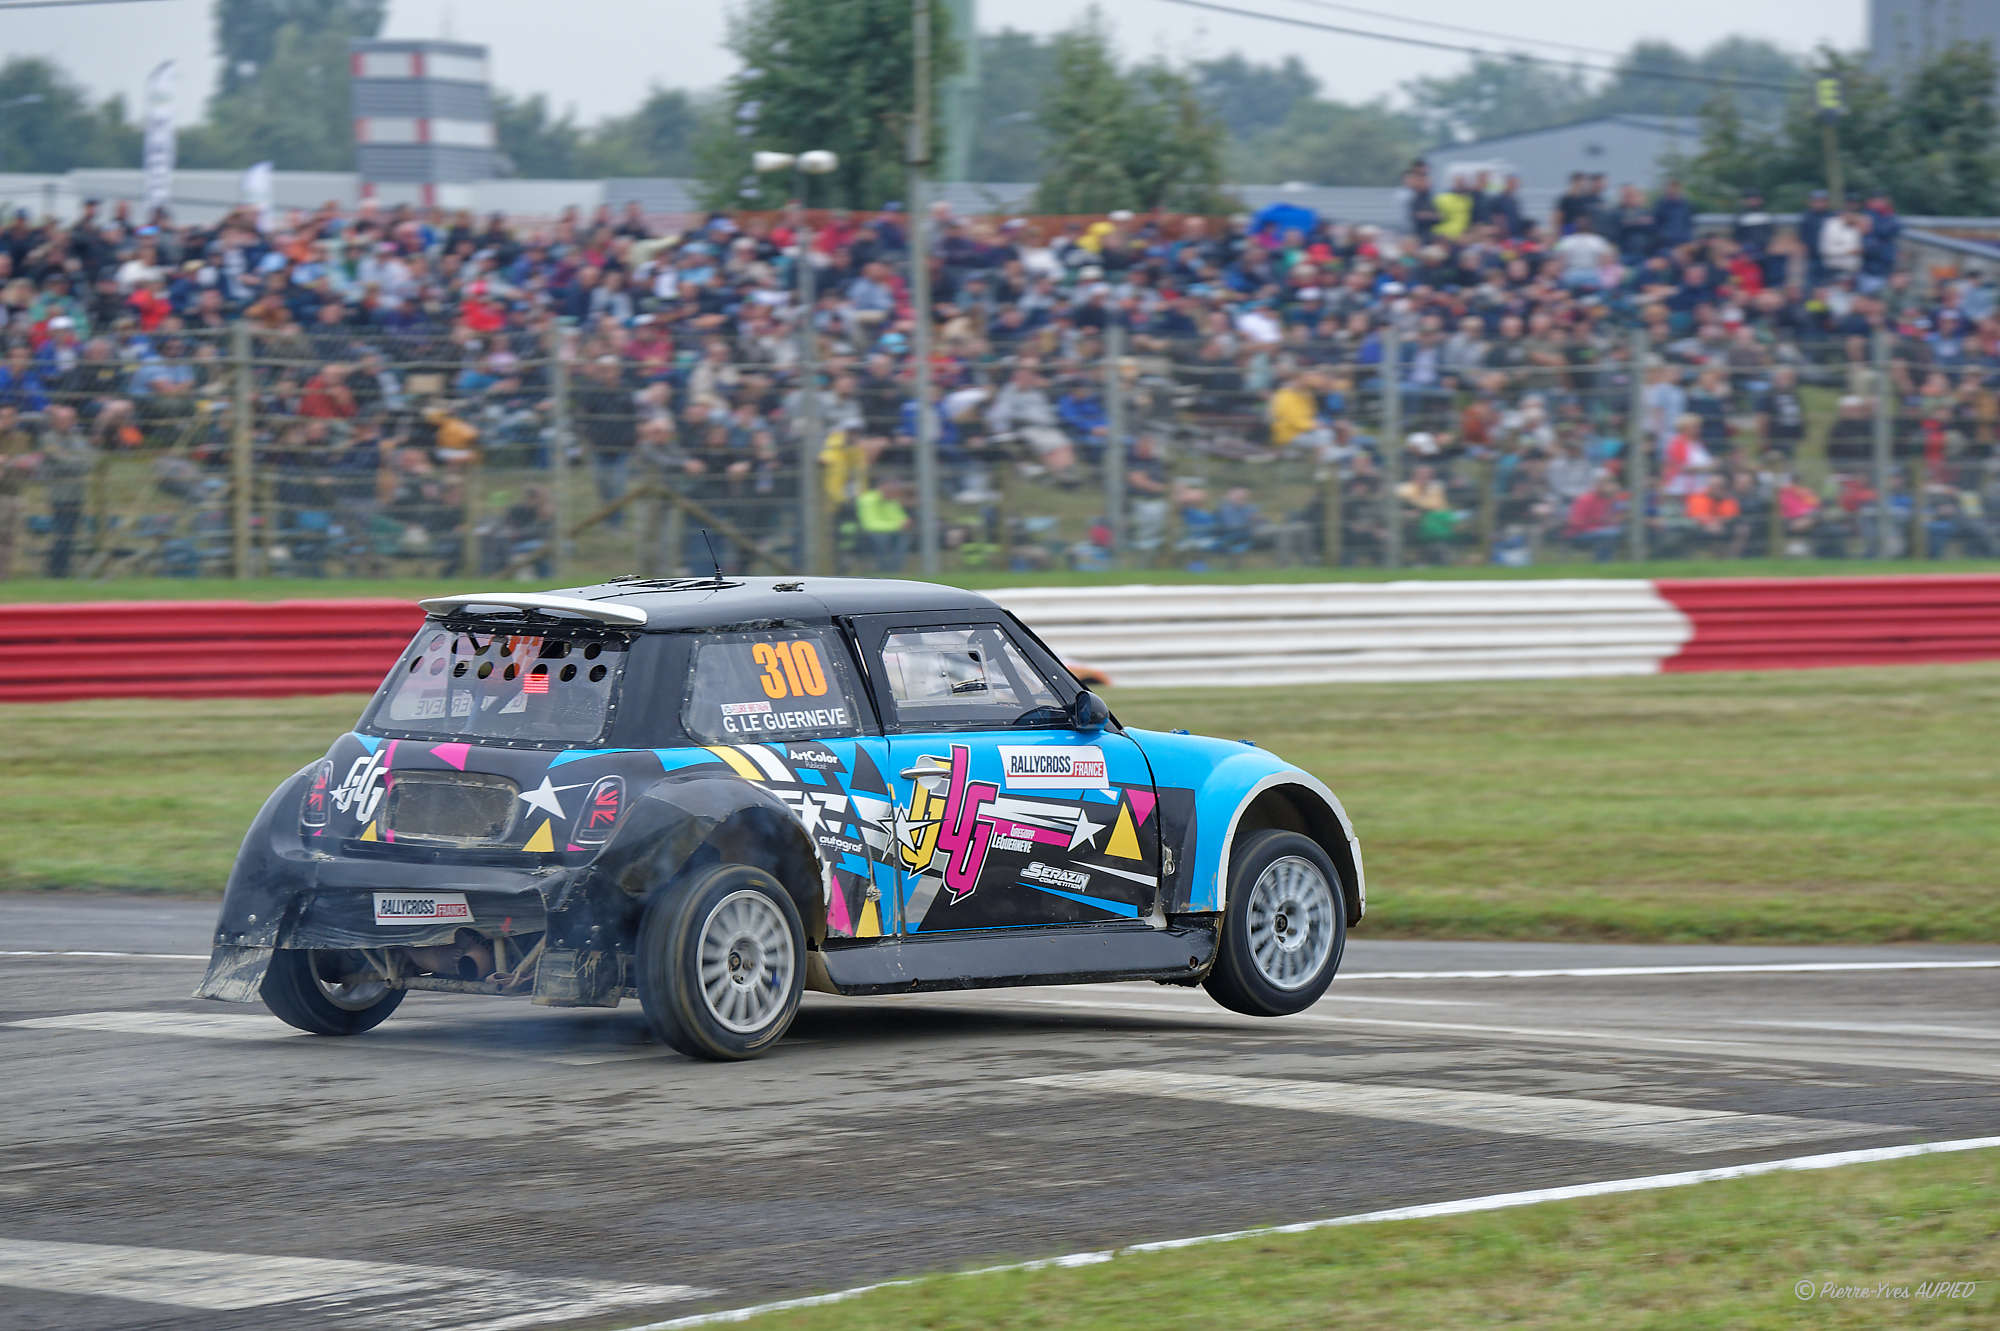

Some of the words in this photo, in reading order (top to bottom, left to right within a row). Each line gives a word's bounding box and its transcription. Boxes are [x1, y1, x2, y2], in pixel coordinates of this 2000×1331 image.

[752, 640, 828, 699] 310
[723, 716, 739, 733] G.
[742, 715, 762, 732] LE
[765, 708, 847, 730] GUERNEVE
[790, 749, 838, 764] ArtColor
[1011, 755, 1071, 773] RALLYCROSS
[1074, 763, 1103, 776] FRANCE
[819, 835, 863, 852] autograf
[1020, 861, 1091, 892] SERAZIN
[380, 899, 435, 915] RALLYCROSS
[439, 905, 466, 916] FRANCE
